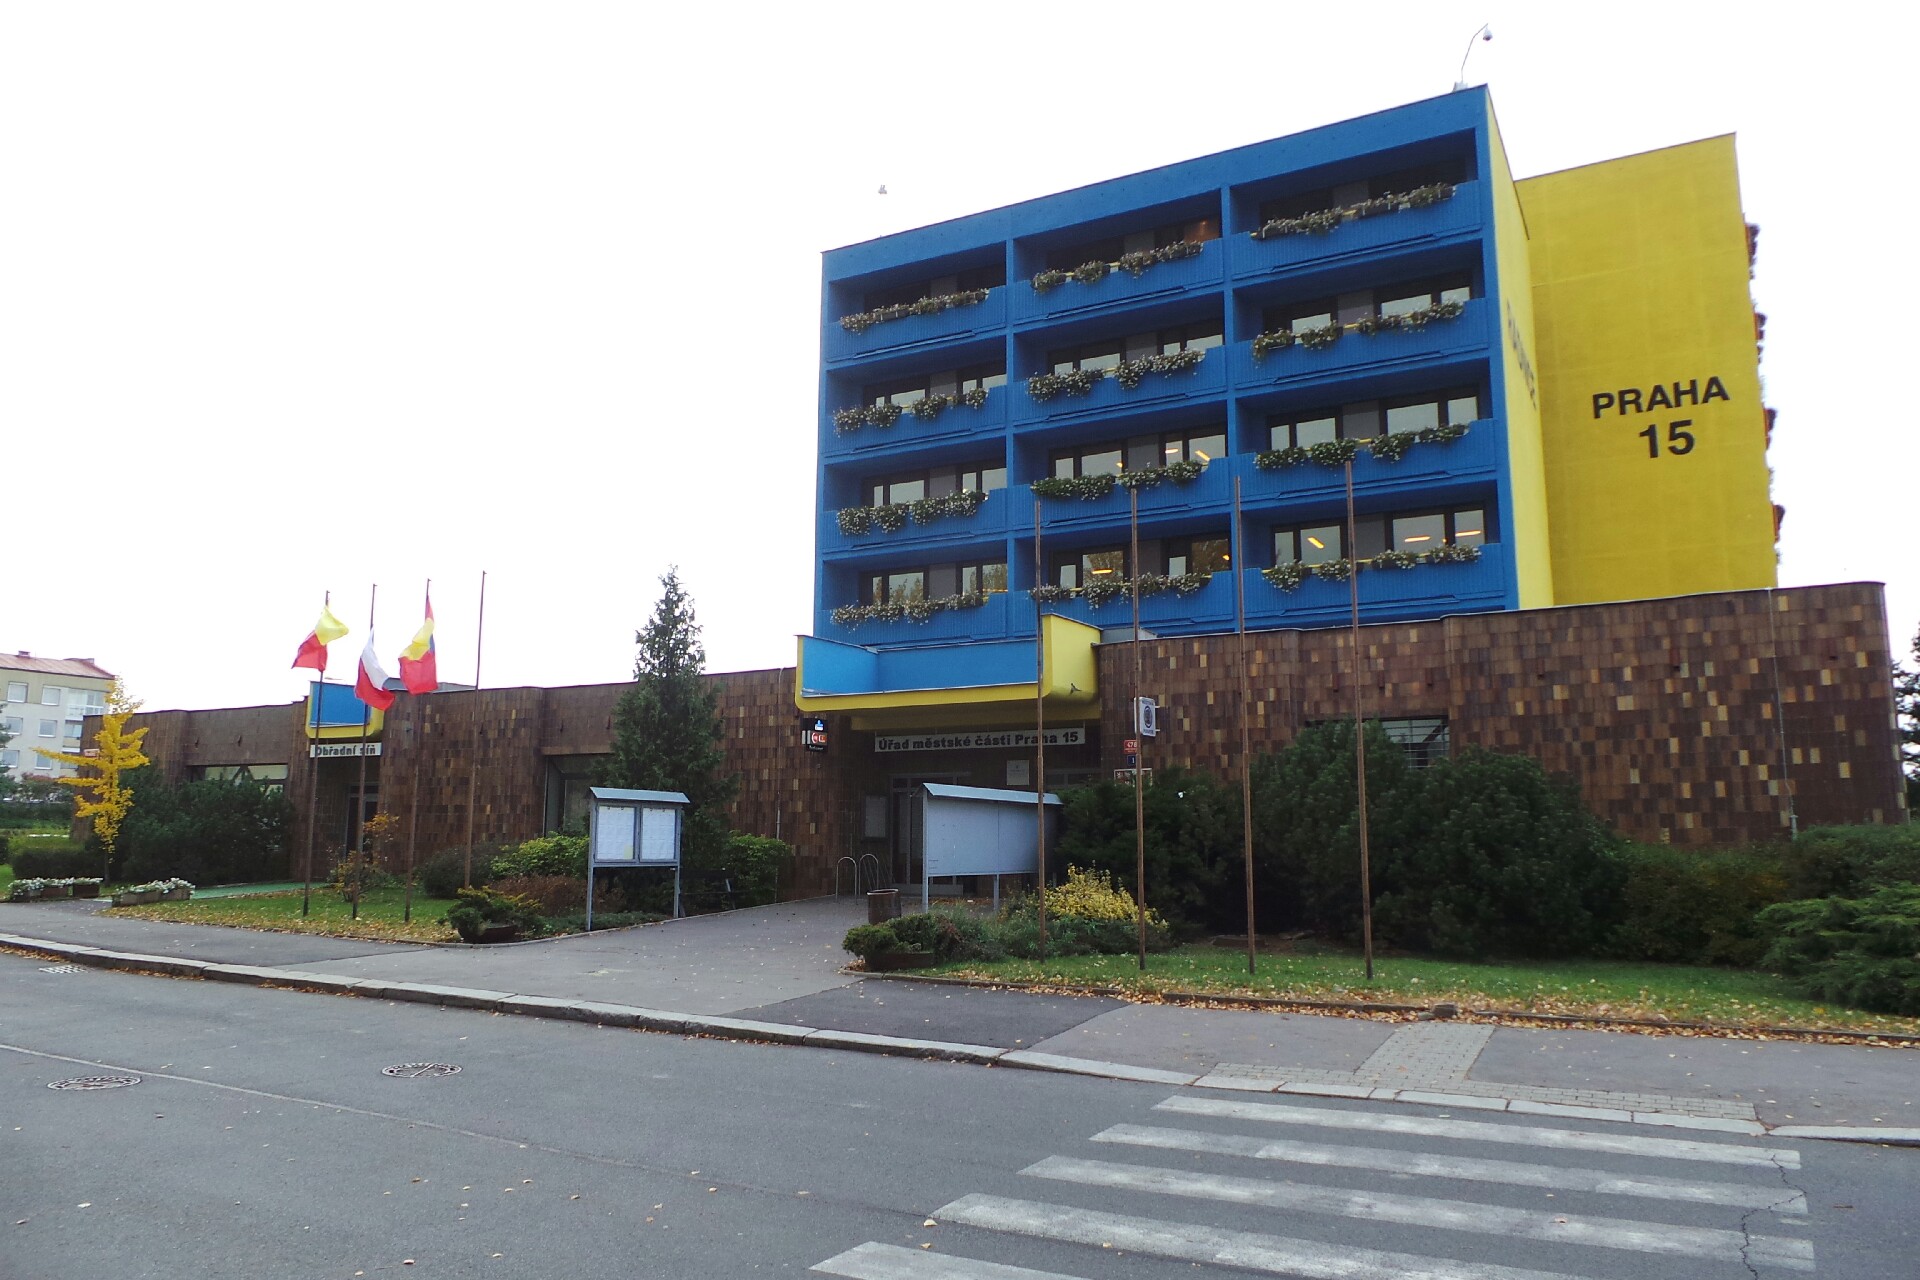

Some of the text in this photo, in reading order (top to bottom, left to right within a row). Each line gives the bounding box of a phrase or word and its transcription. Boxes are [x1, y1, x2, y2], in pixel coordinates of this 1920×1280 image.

[1592, 375, 1730, 419] PRAHA
[1639, 419, 1695, 459] 15
[878, 731, 1079, 750] Úřad městské části Praha 15
